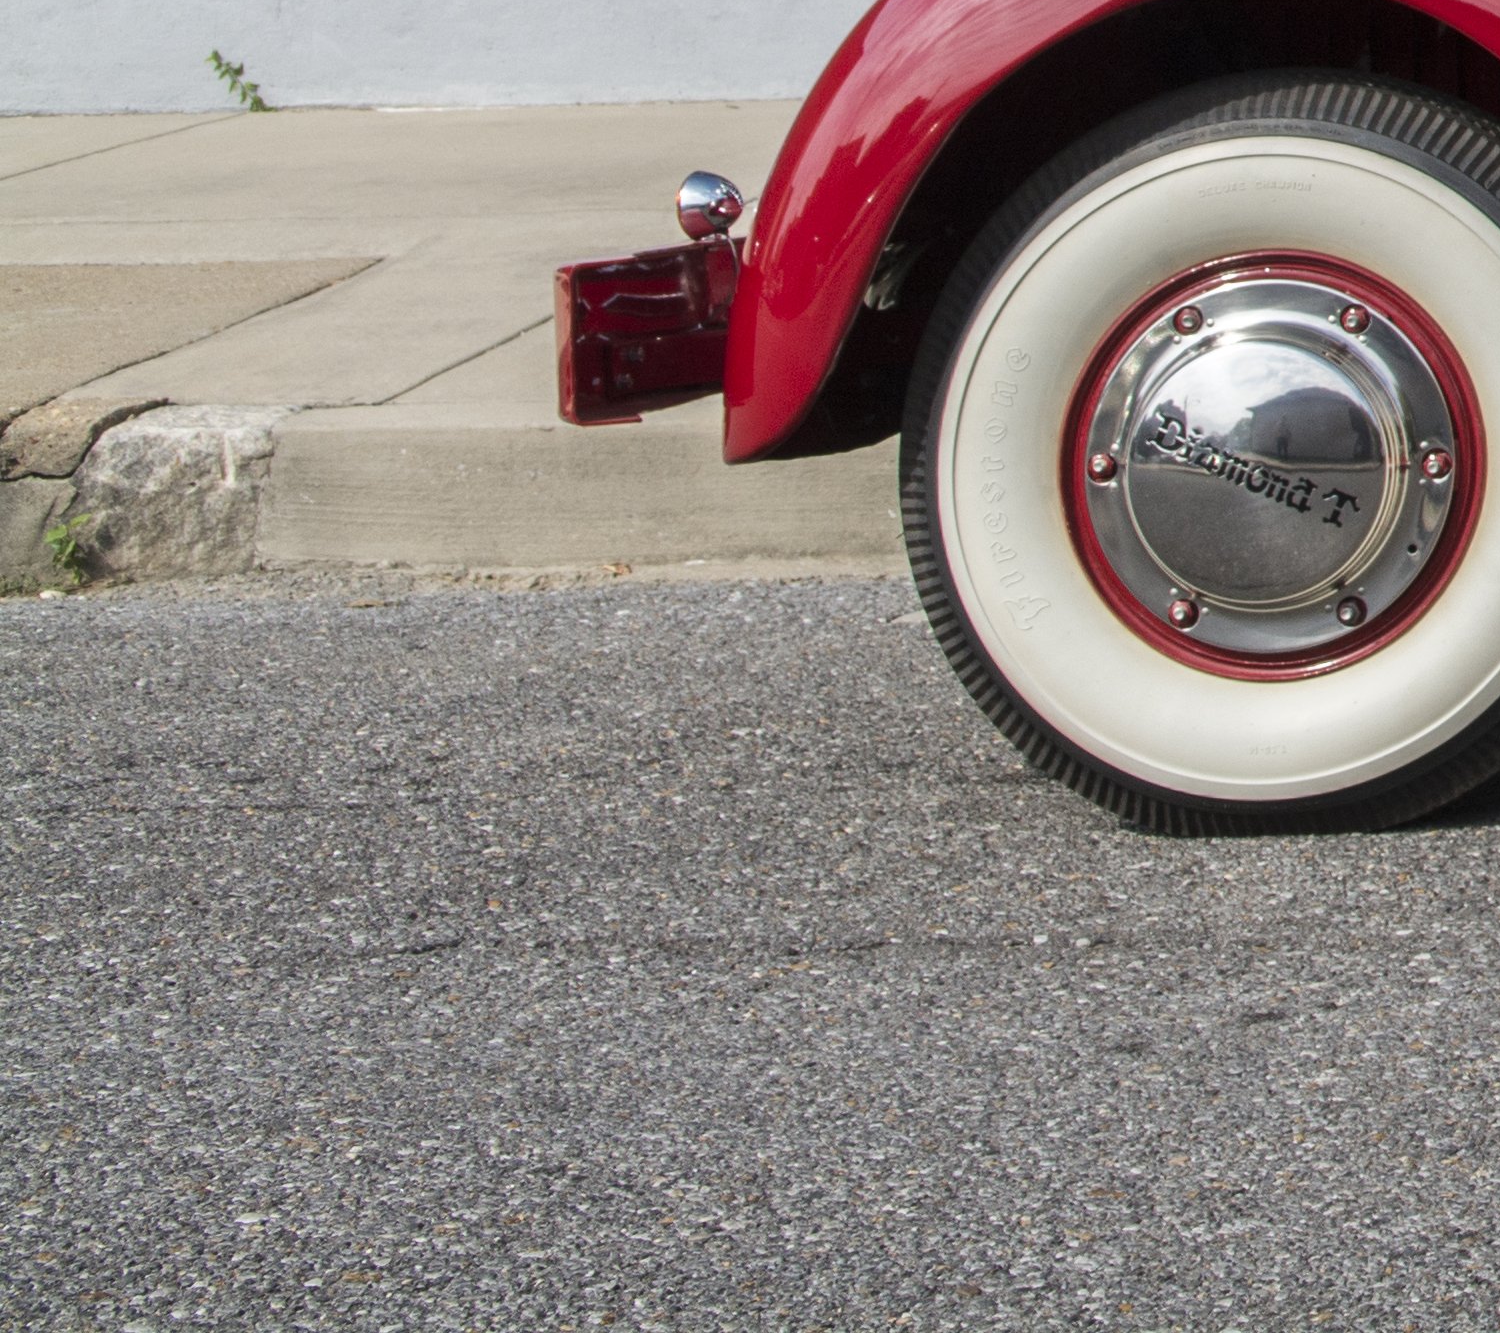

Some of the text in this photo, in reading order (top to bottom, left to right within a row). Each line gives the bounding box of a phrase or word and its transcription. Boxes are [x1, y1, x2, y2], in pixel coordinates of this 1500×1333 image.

[980, 347, 1051, 630] Firestone
[1145, 410, 1361, 529] Diamond T
